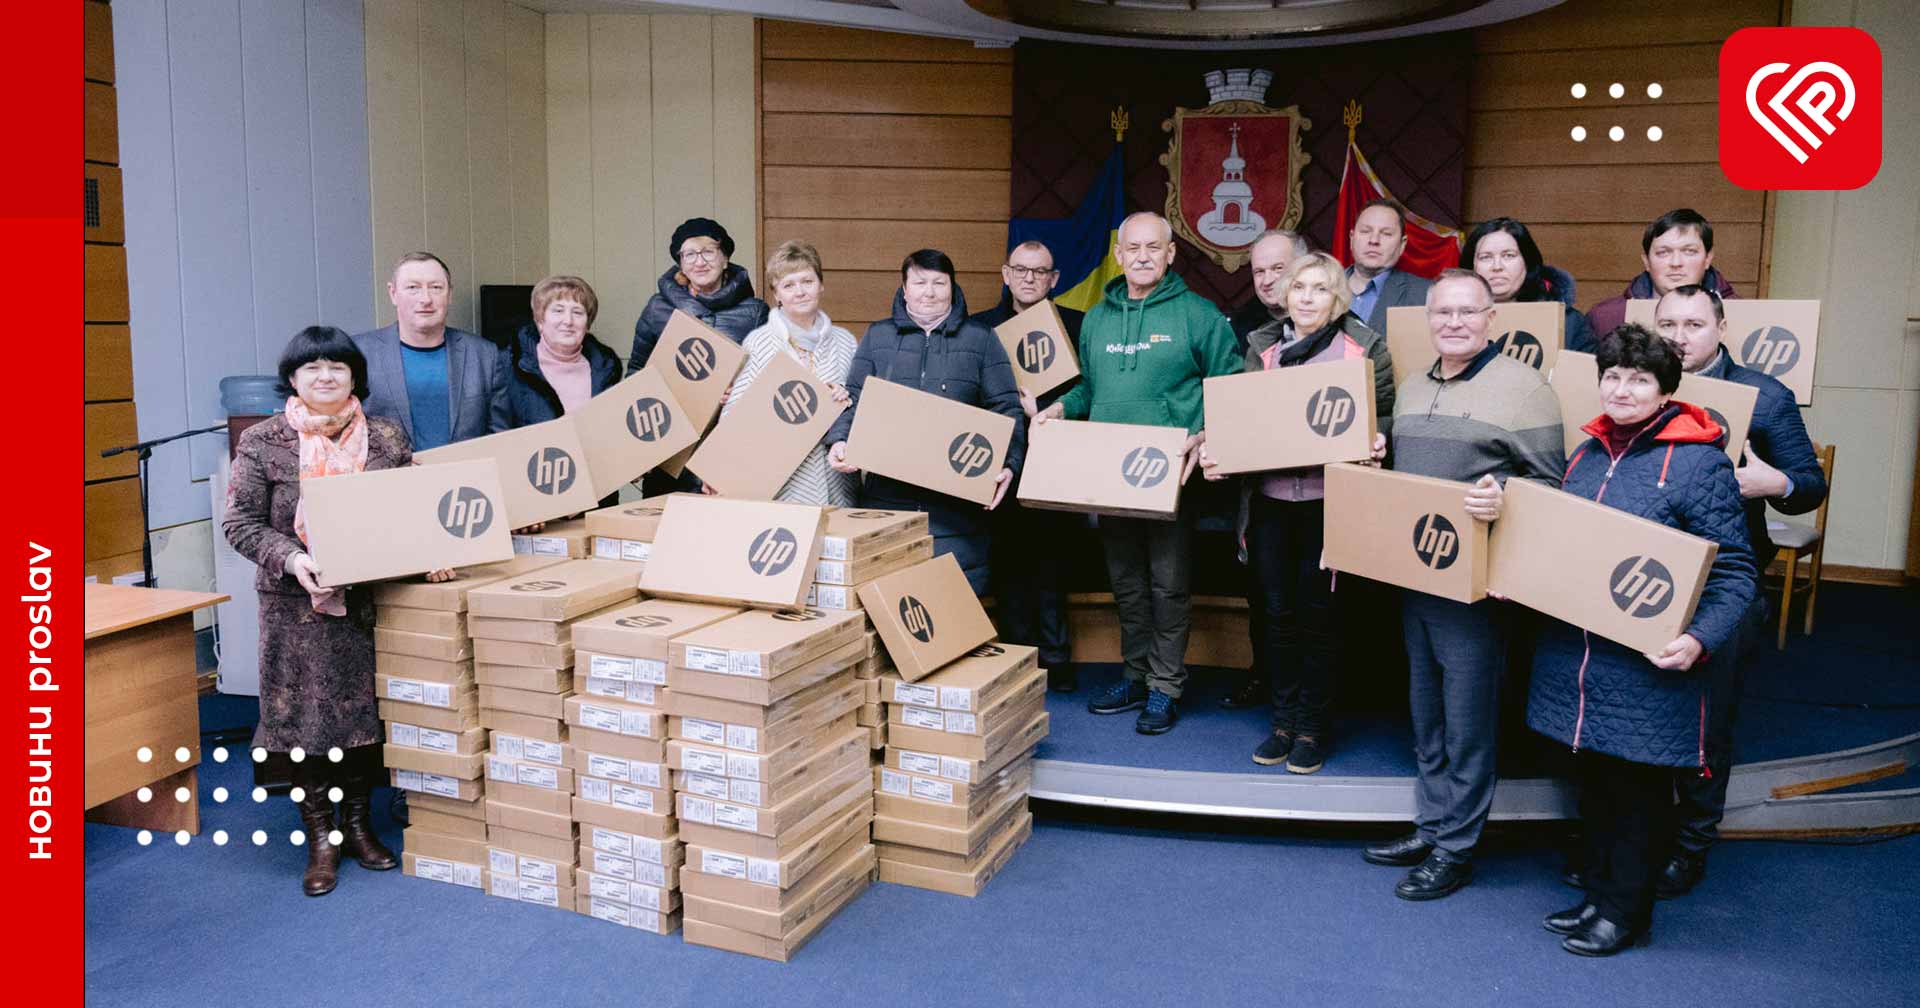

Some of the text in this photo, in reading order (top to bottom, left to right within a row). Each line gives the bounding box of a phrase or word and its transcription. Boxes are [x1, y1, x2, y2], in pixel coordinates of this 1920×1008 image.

[677, 339, 713, 380] hp
[1026, 331, 1051, 373] hp
[1748, 326, 1797, 376] hp
[634, 398, 665, 441] hp
[775, 382, 815, 423] hp
[1311, 387, 1351, 437] hp
[534, 448, 571, 495] hp
[953, 432, 991, 478] hp
[1126, 447, 1166, 488] hp
[445, 487, 488, 538] hp
[751, 527, 795, 576] hp
[1417, 513, 1457, 569] hp
[1613, 556, 1672, 618] hp
